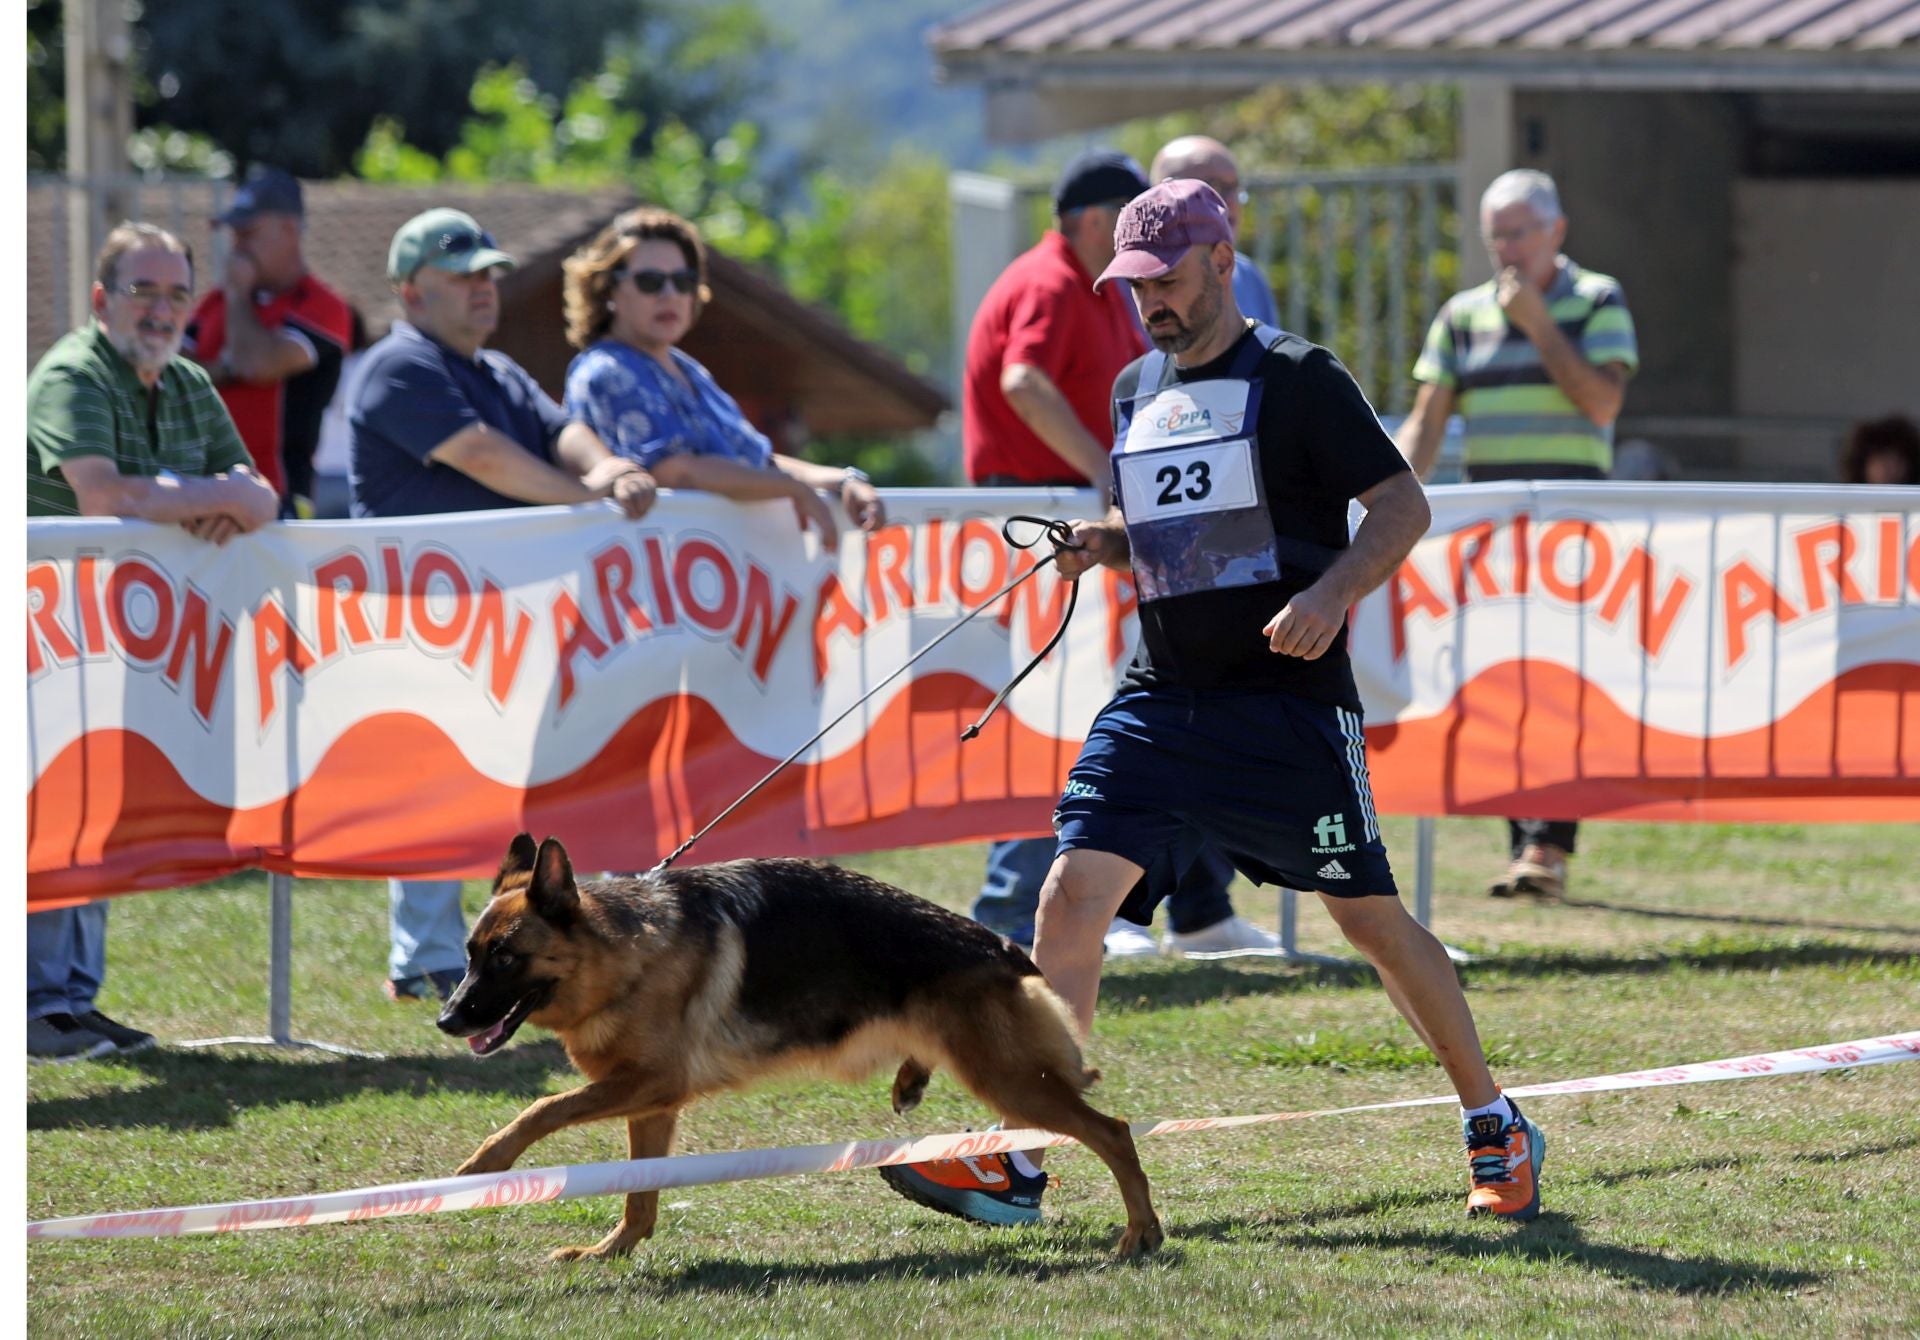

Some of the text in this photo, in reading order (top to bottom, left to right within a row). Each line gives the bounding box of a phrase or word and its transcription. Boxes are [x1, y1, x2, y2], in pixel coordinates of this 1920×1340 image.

[1156, 461, 1212, 505] 23
[253, 543, 533, 730] ARION
[551, 534, 799, 709] ARION
[1386, 512, 1692, 666] ARION
[1723, 515, 1920, 668] ARI
[1312, 844, 1356, 853] network
[1317, 871, 1351, 879] adidas
